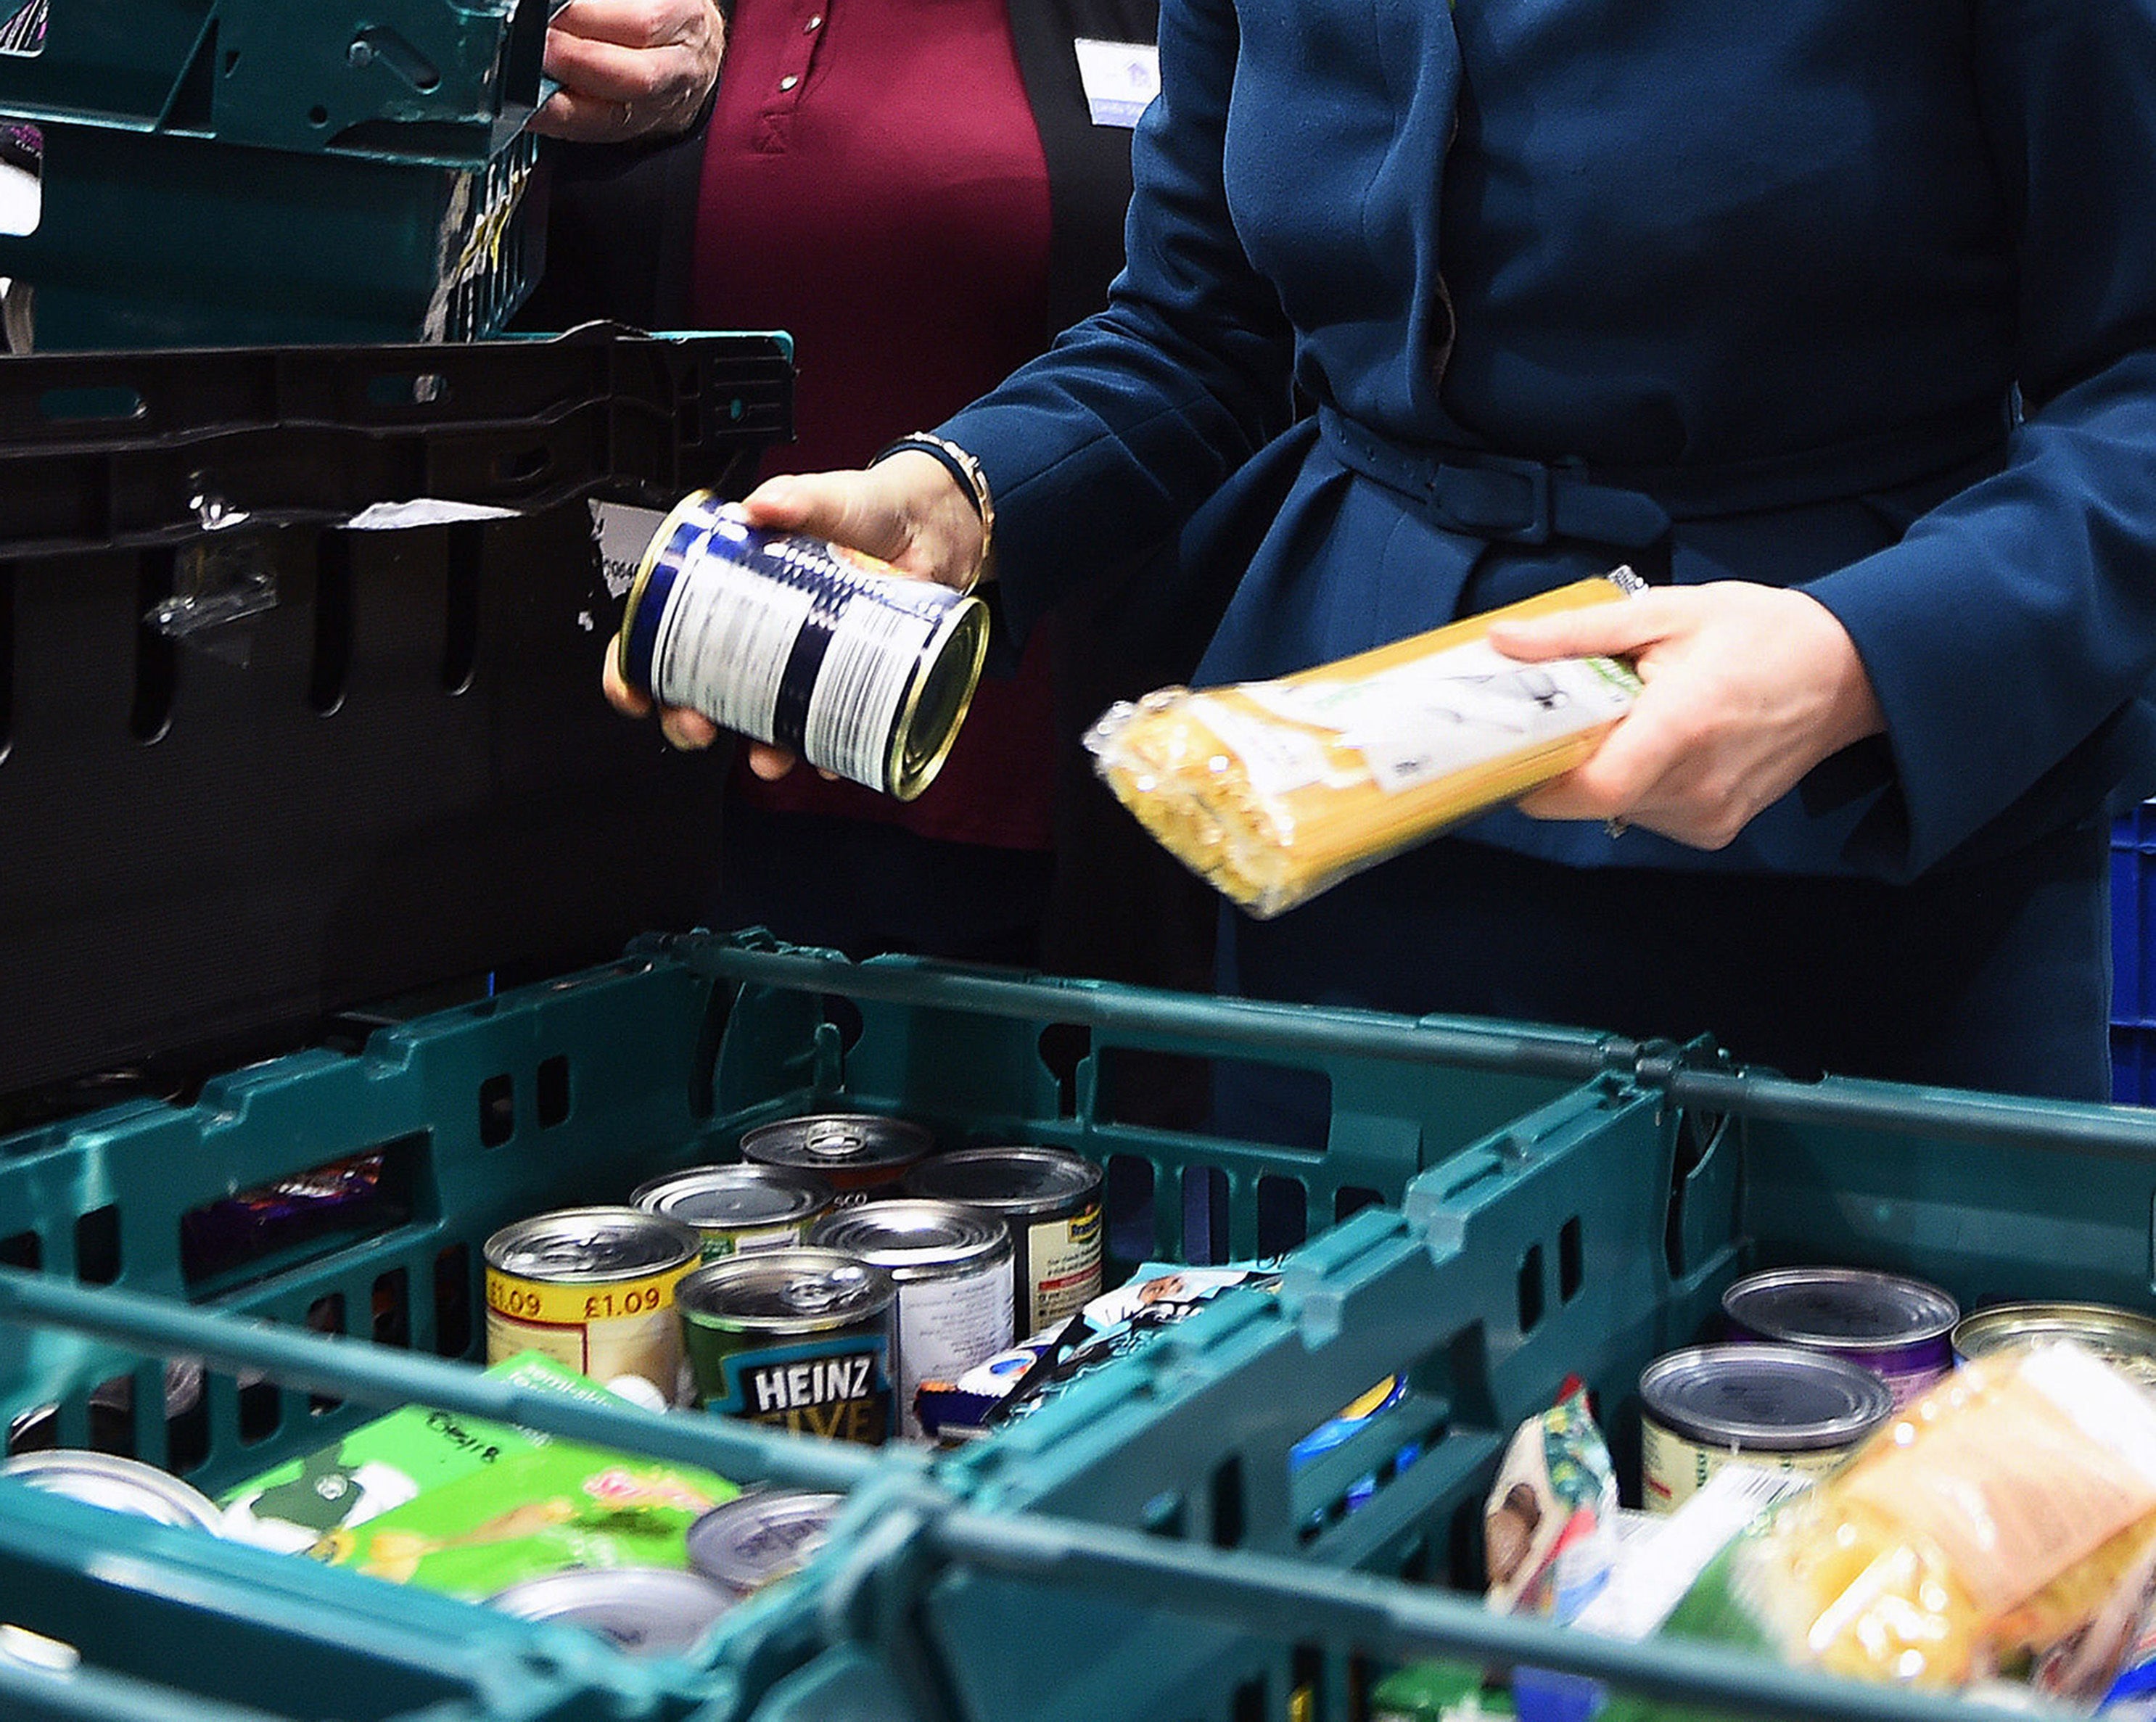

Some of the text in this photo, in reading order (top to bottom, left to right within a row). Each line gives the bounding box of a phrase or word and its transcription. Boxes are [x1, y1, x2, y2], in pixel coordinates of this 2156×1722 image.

[833, 1193, 868, 1207] SCO
[583, 1287, 661, 1319] £1.09
[755, 1355, 871, 1412] HEINZ
